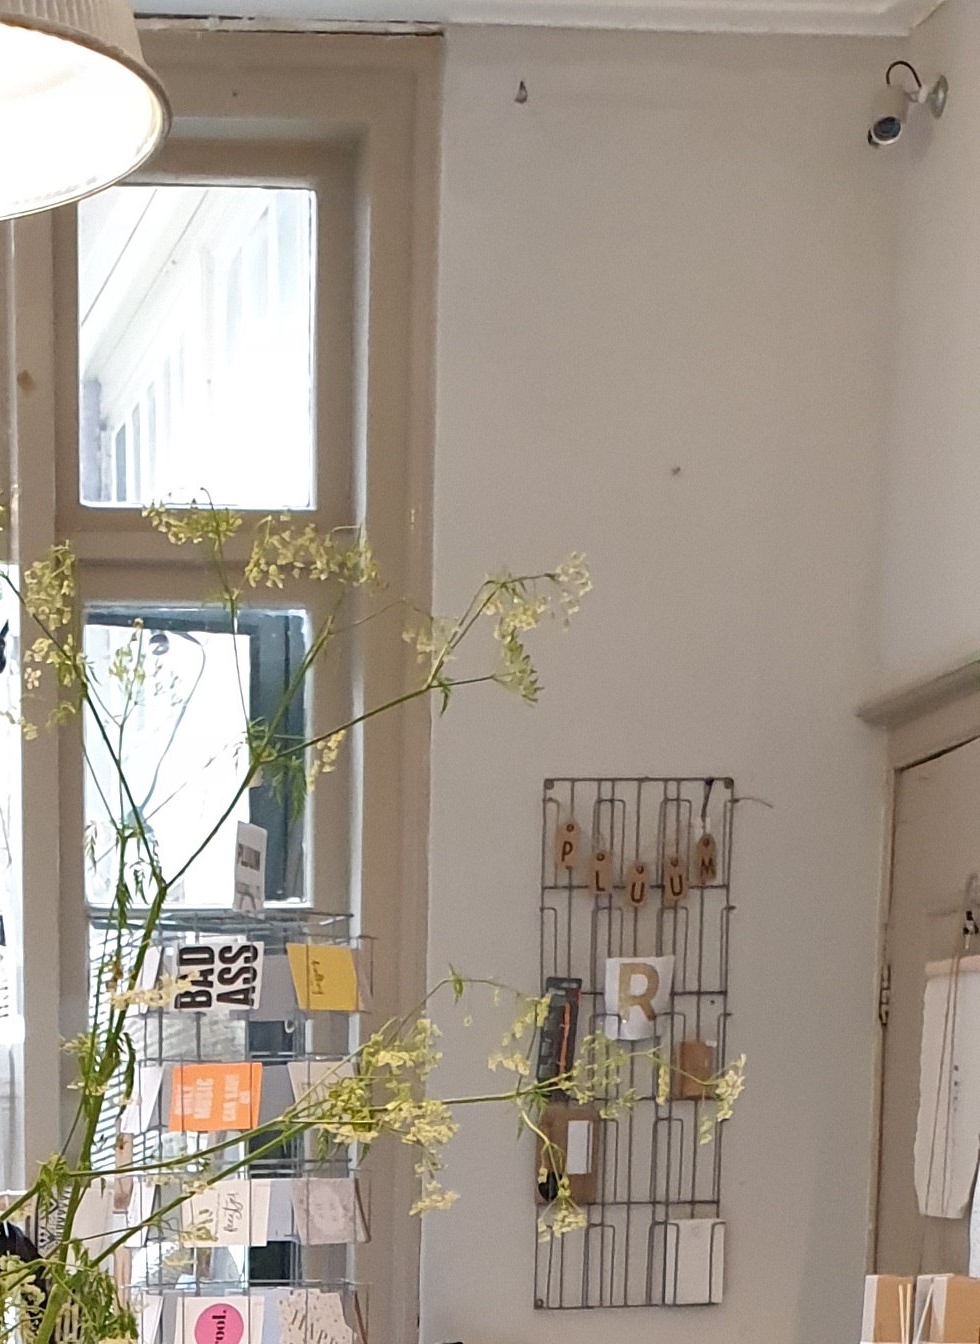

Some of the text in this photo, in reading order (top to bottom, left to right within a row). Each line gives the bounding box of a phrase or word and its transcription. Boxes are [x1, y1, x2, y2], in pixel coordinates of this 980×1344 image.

[561, 840, 717, 903] PLUUM
[173, 945, 216, 1009] BAD
[216, 944, 259, 1007] ASS
[619, 961, 660, 1022] R
